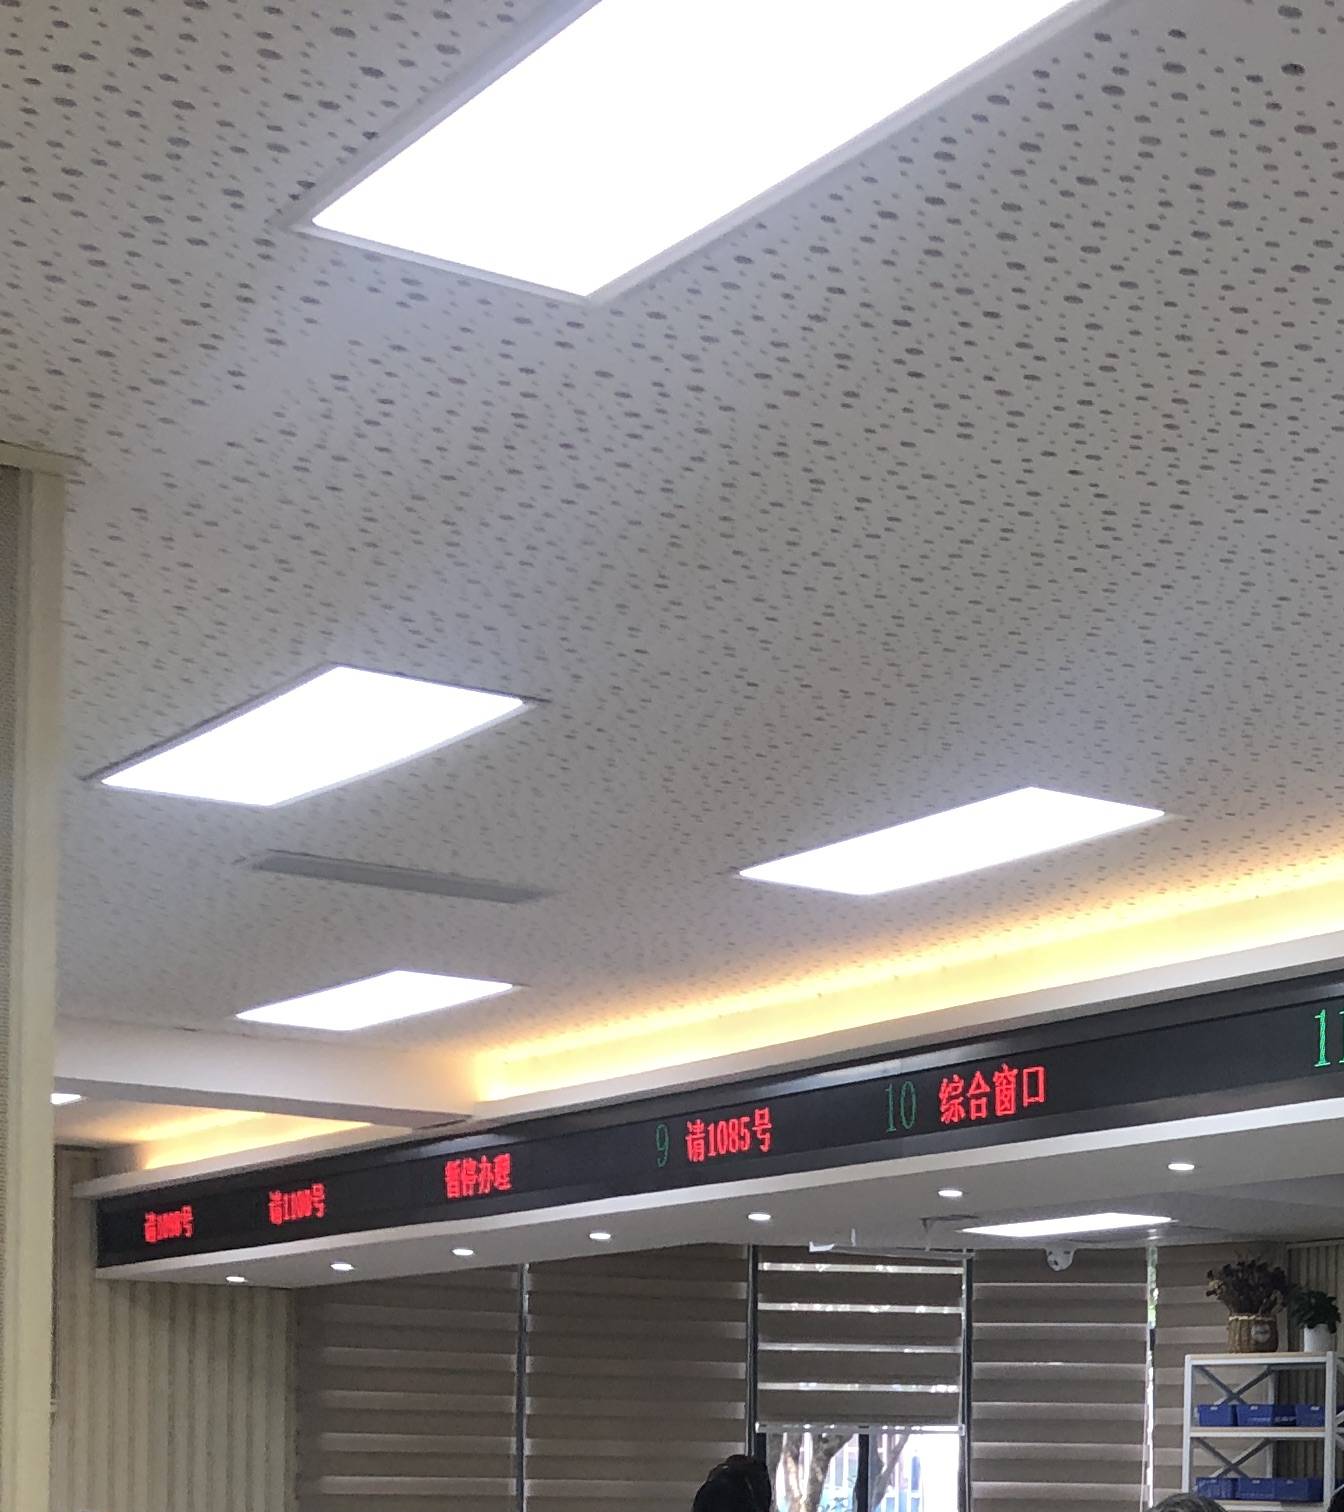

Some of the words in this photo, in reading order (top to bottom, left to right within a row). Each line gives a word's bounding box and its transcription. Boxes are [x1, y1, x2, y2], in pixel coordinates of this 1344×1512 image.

[887, 1081, 916, 1131] 10
[940, 1066, 1045, 1124] 综合窗口
[656, 1124, 669, 1167] 9
[688, 1109, 773, 1162] 请1085号
